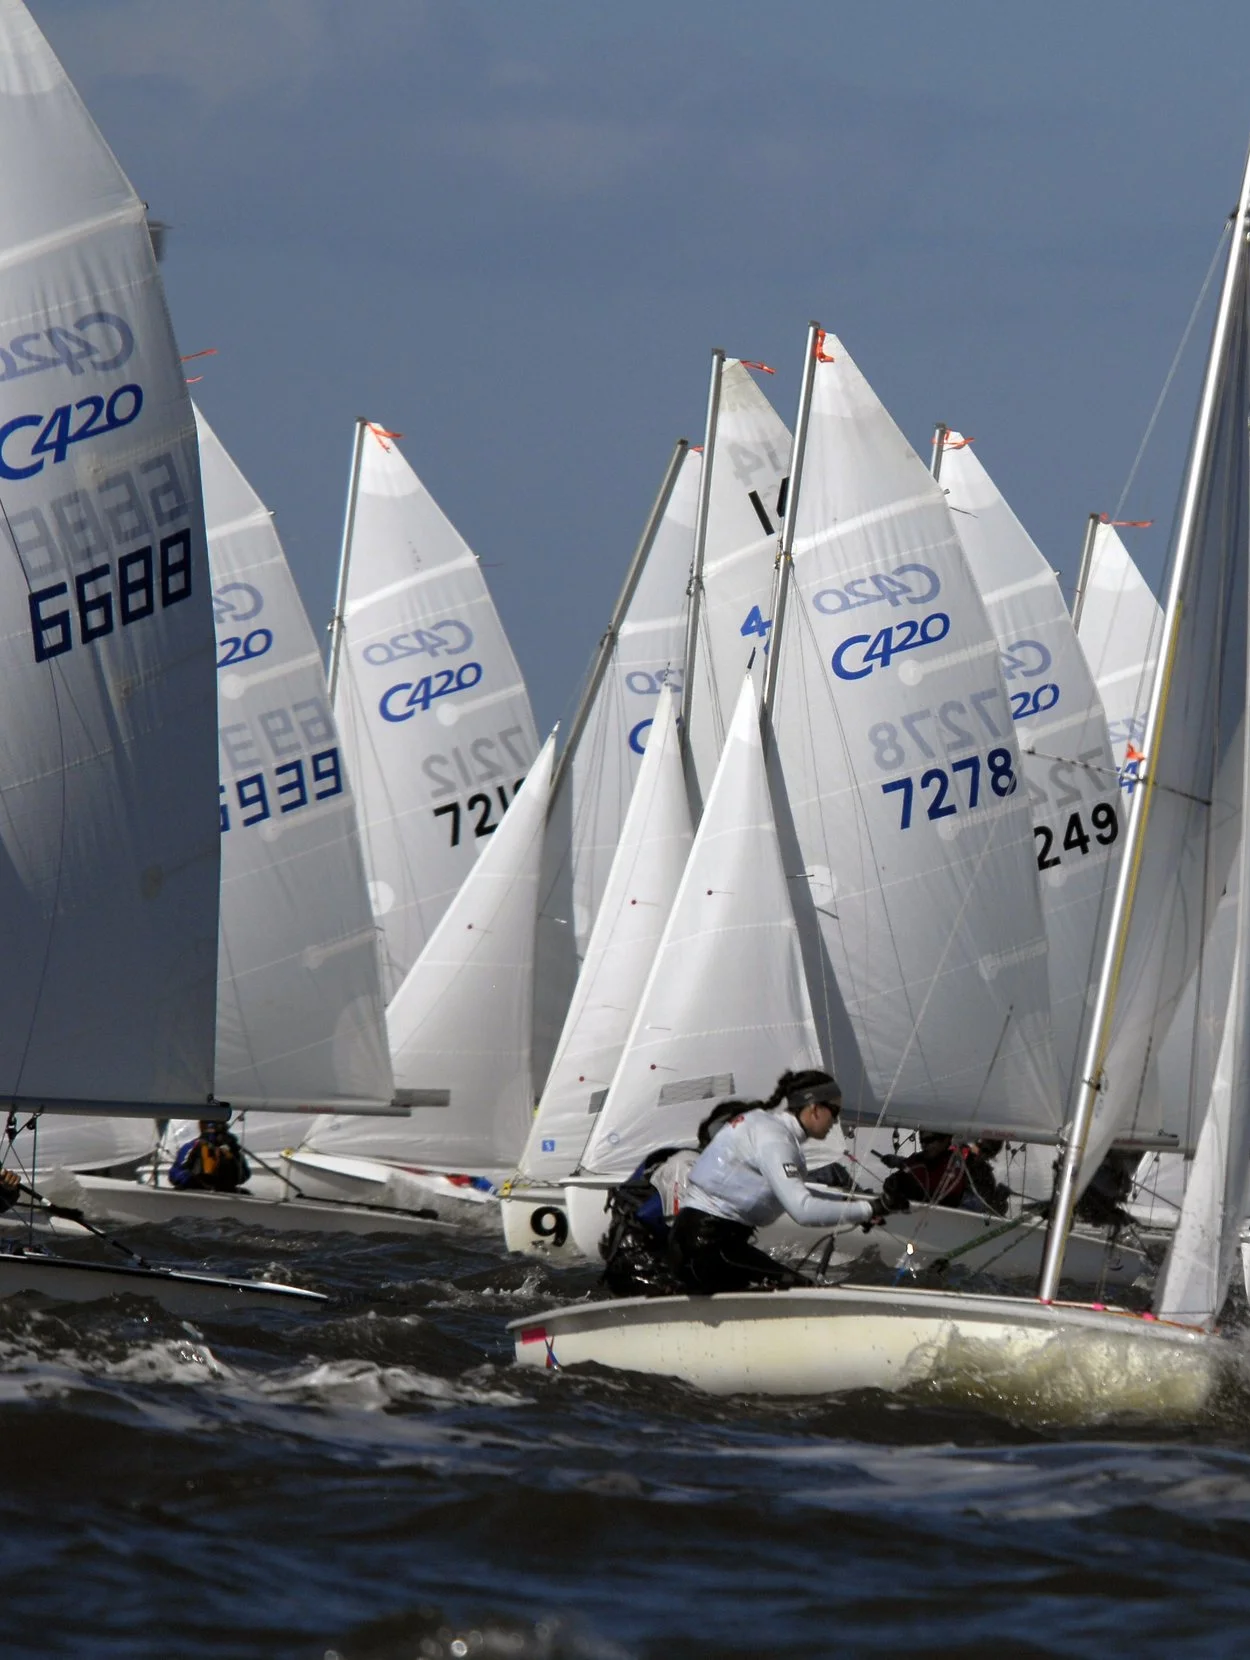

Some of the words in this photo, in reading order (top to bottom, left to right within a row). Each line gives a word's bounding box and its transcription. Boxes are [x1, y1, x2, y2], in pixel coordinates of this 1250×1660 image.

[0, 384, 144, 480] C420
[28, 528, 192, 663] 6688
[217, 628, 273, 668] 20
[832, 612, 950, 680] C420
[379, 662, 483, 722] C420
[1010, 683, 1059, 720] 20
[881, 748, 1017, 830] 7278
[1034, 803, 1119, 871] 249
[530, 1206, 569, 1248] 9
